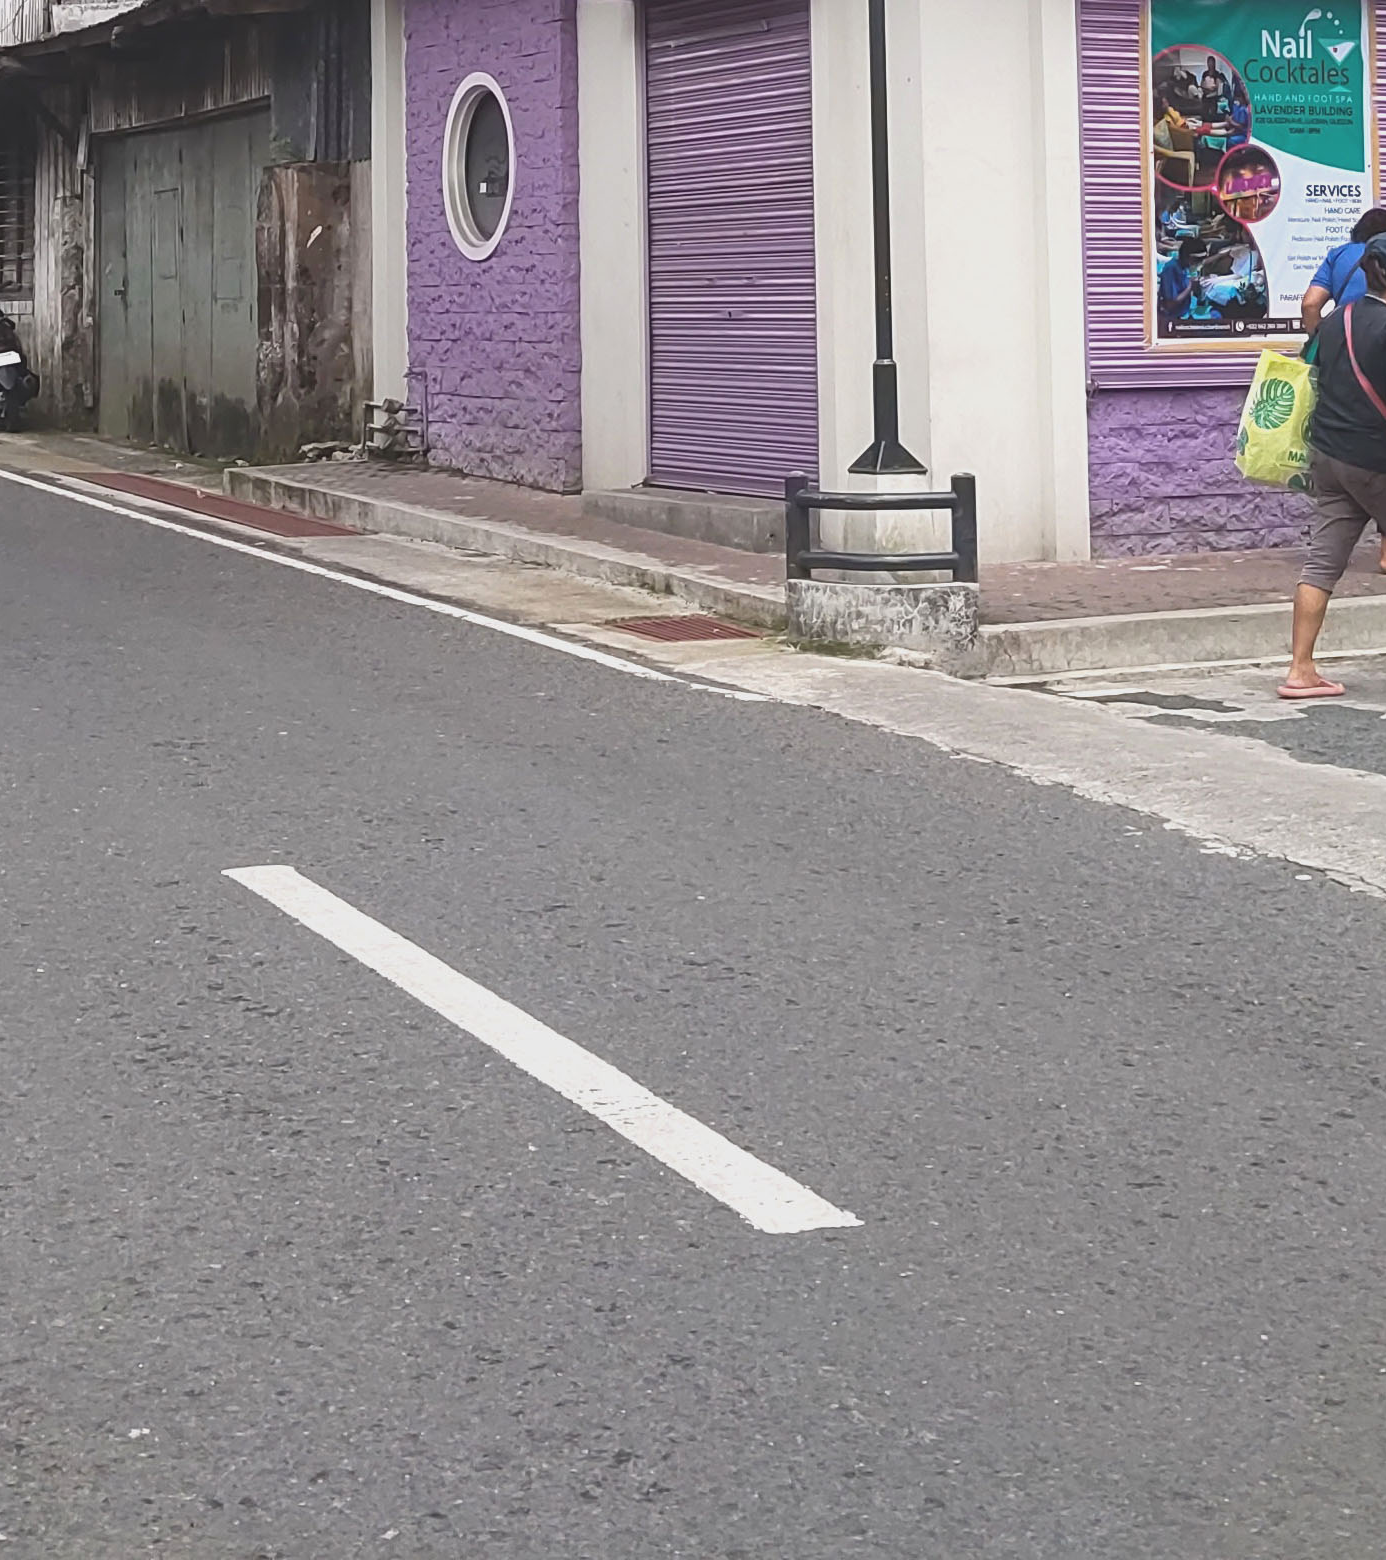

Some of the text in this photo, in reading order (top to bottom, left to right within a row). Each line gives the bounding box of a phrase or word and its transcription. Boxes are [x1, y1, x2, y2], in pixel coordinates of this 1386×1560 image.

[1261, 29, 1312, 59] Nail
[1244, 58, 1349, 86] Cocktales
[1255, 93, 1281, 102] HAND
[1285, 94, 1304, 102] AND
[1336, 95, 1352, 103] SPA
[1255, 105, 1352, 116] LAVENDER BUILDING
[1306, 185, 1361, 197] SERVICES
